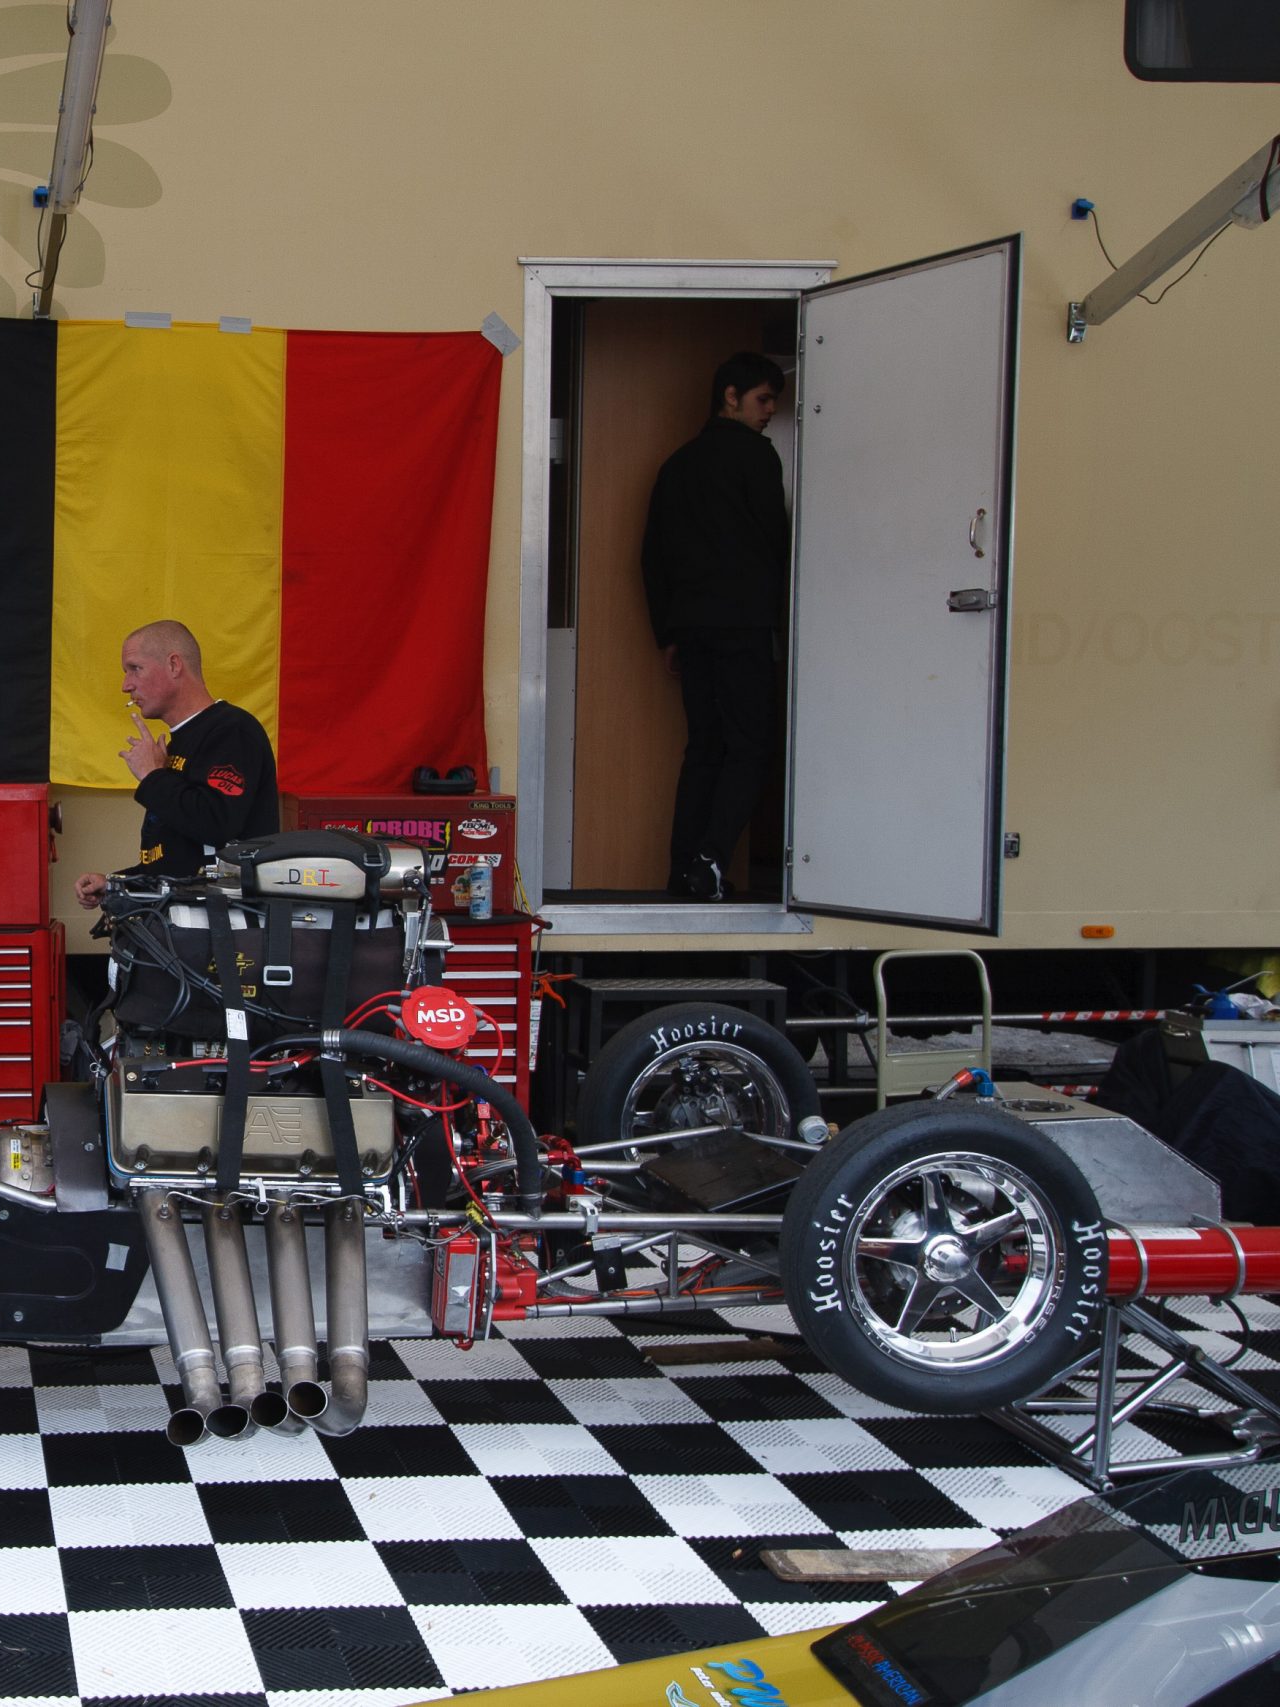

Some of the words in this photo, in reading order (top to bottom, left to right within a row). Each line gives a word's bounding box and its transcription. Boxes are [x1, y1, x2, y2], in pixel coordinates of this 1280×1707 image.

[209, 769, 244, 785] LUCAS
[218, 781, 234, 793] OIL
[372, 820, 446, 844] PROBE
[417, 1008, 466, 1024] MSD
[650, 1022, 744, 1054] Hoosier
[810, 1193, 854, 1312] Hoosier
[1065, 1220, 1105, 1341] Hoosier
[1024, 1252, 1066, 1344] FORGED
[873, 1658, 925, 1705] AMERICAN
